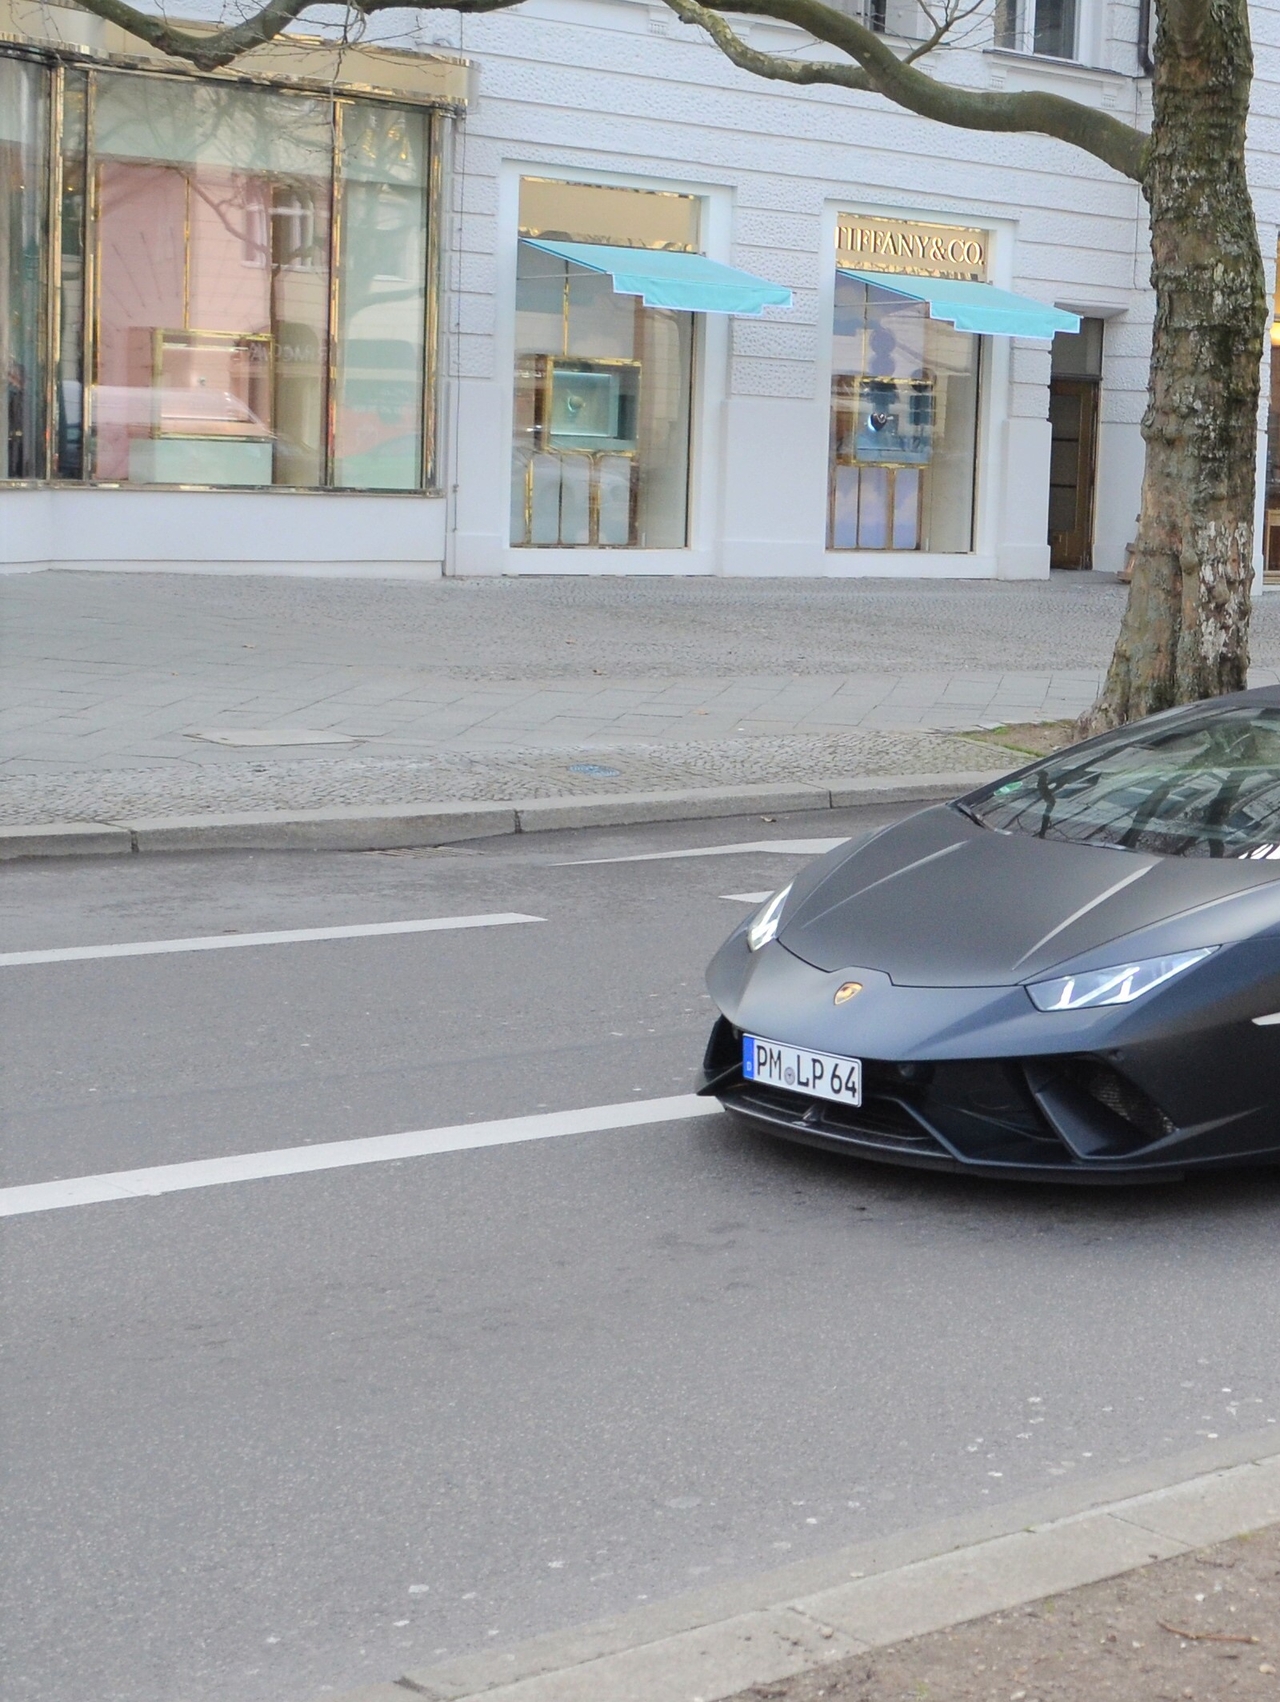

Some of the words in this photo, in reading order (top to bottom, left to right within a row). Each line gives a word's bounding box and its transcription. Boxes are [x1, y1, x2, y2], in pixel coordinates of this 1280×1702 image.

[756, 1045, 782, 1080] PM
[797, 1054, 824, 1089] LP
[830, 1063, 857, 1098] 64
